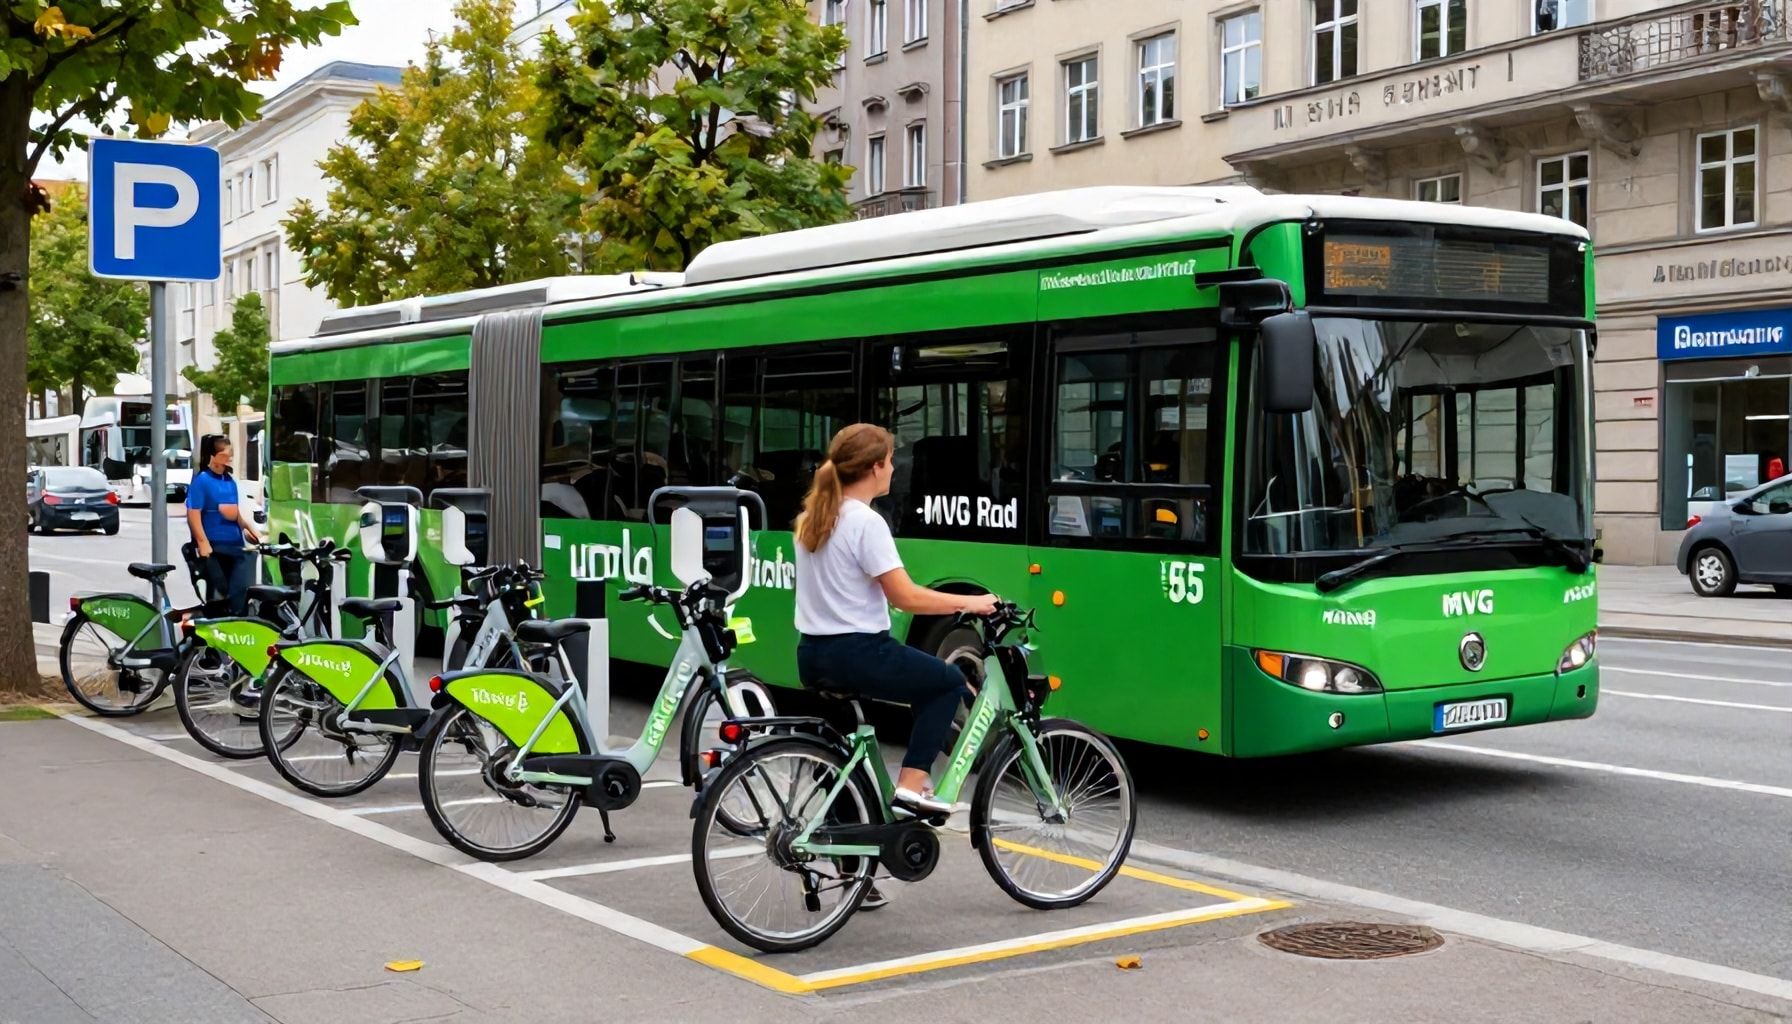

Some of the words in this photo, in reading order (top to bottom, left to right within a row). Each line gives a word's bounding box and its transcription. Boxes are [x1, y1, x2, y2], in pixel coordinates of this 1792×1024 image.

[114, 162, 199, 260] P
[977, 496, 1017, 529] Rad
[1443, 589, 1494, 618] MVG
